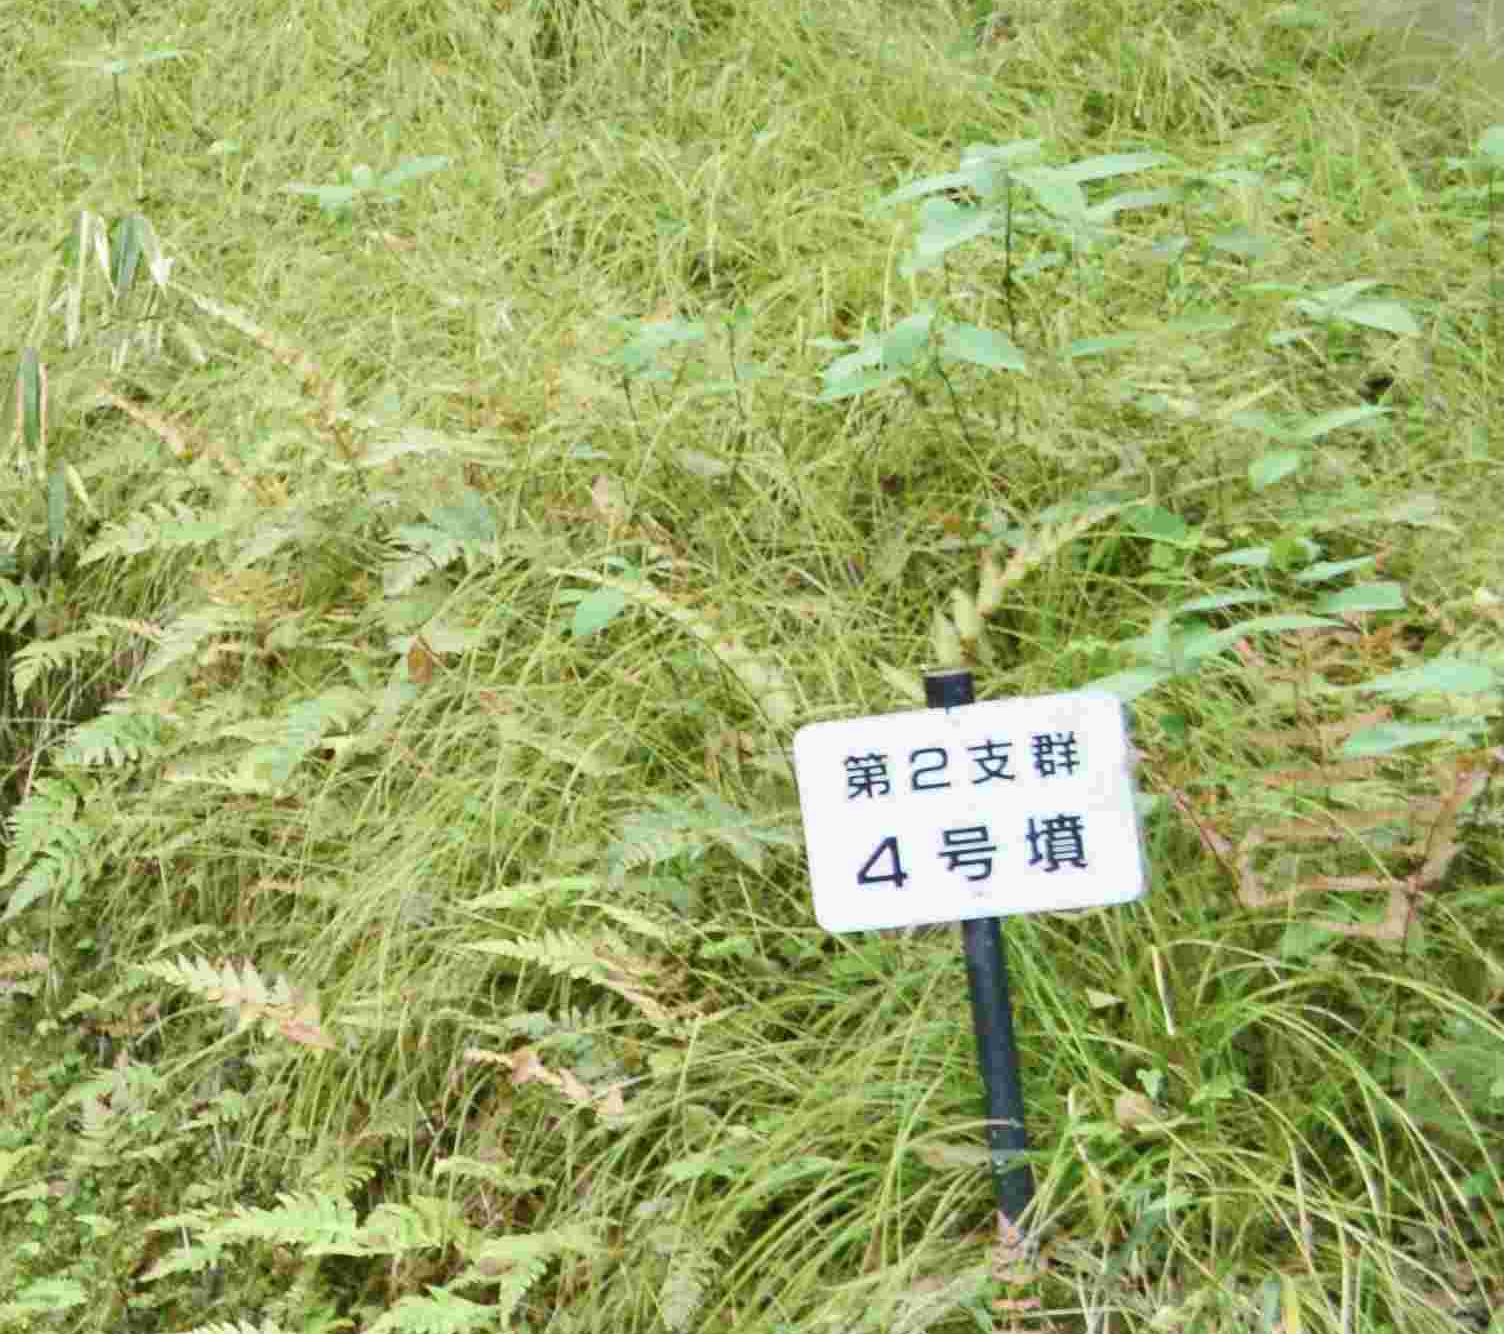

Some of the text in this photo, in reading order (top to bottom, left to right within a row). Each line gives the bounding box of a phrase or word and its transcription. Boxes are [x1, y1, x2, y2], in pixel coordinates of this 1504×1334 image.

[843, 731, 1080, 799] 第2支群
[856, 813, 1088, 888] 4号墳
